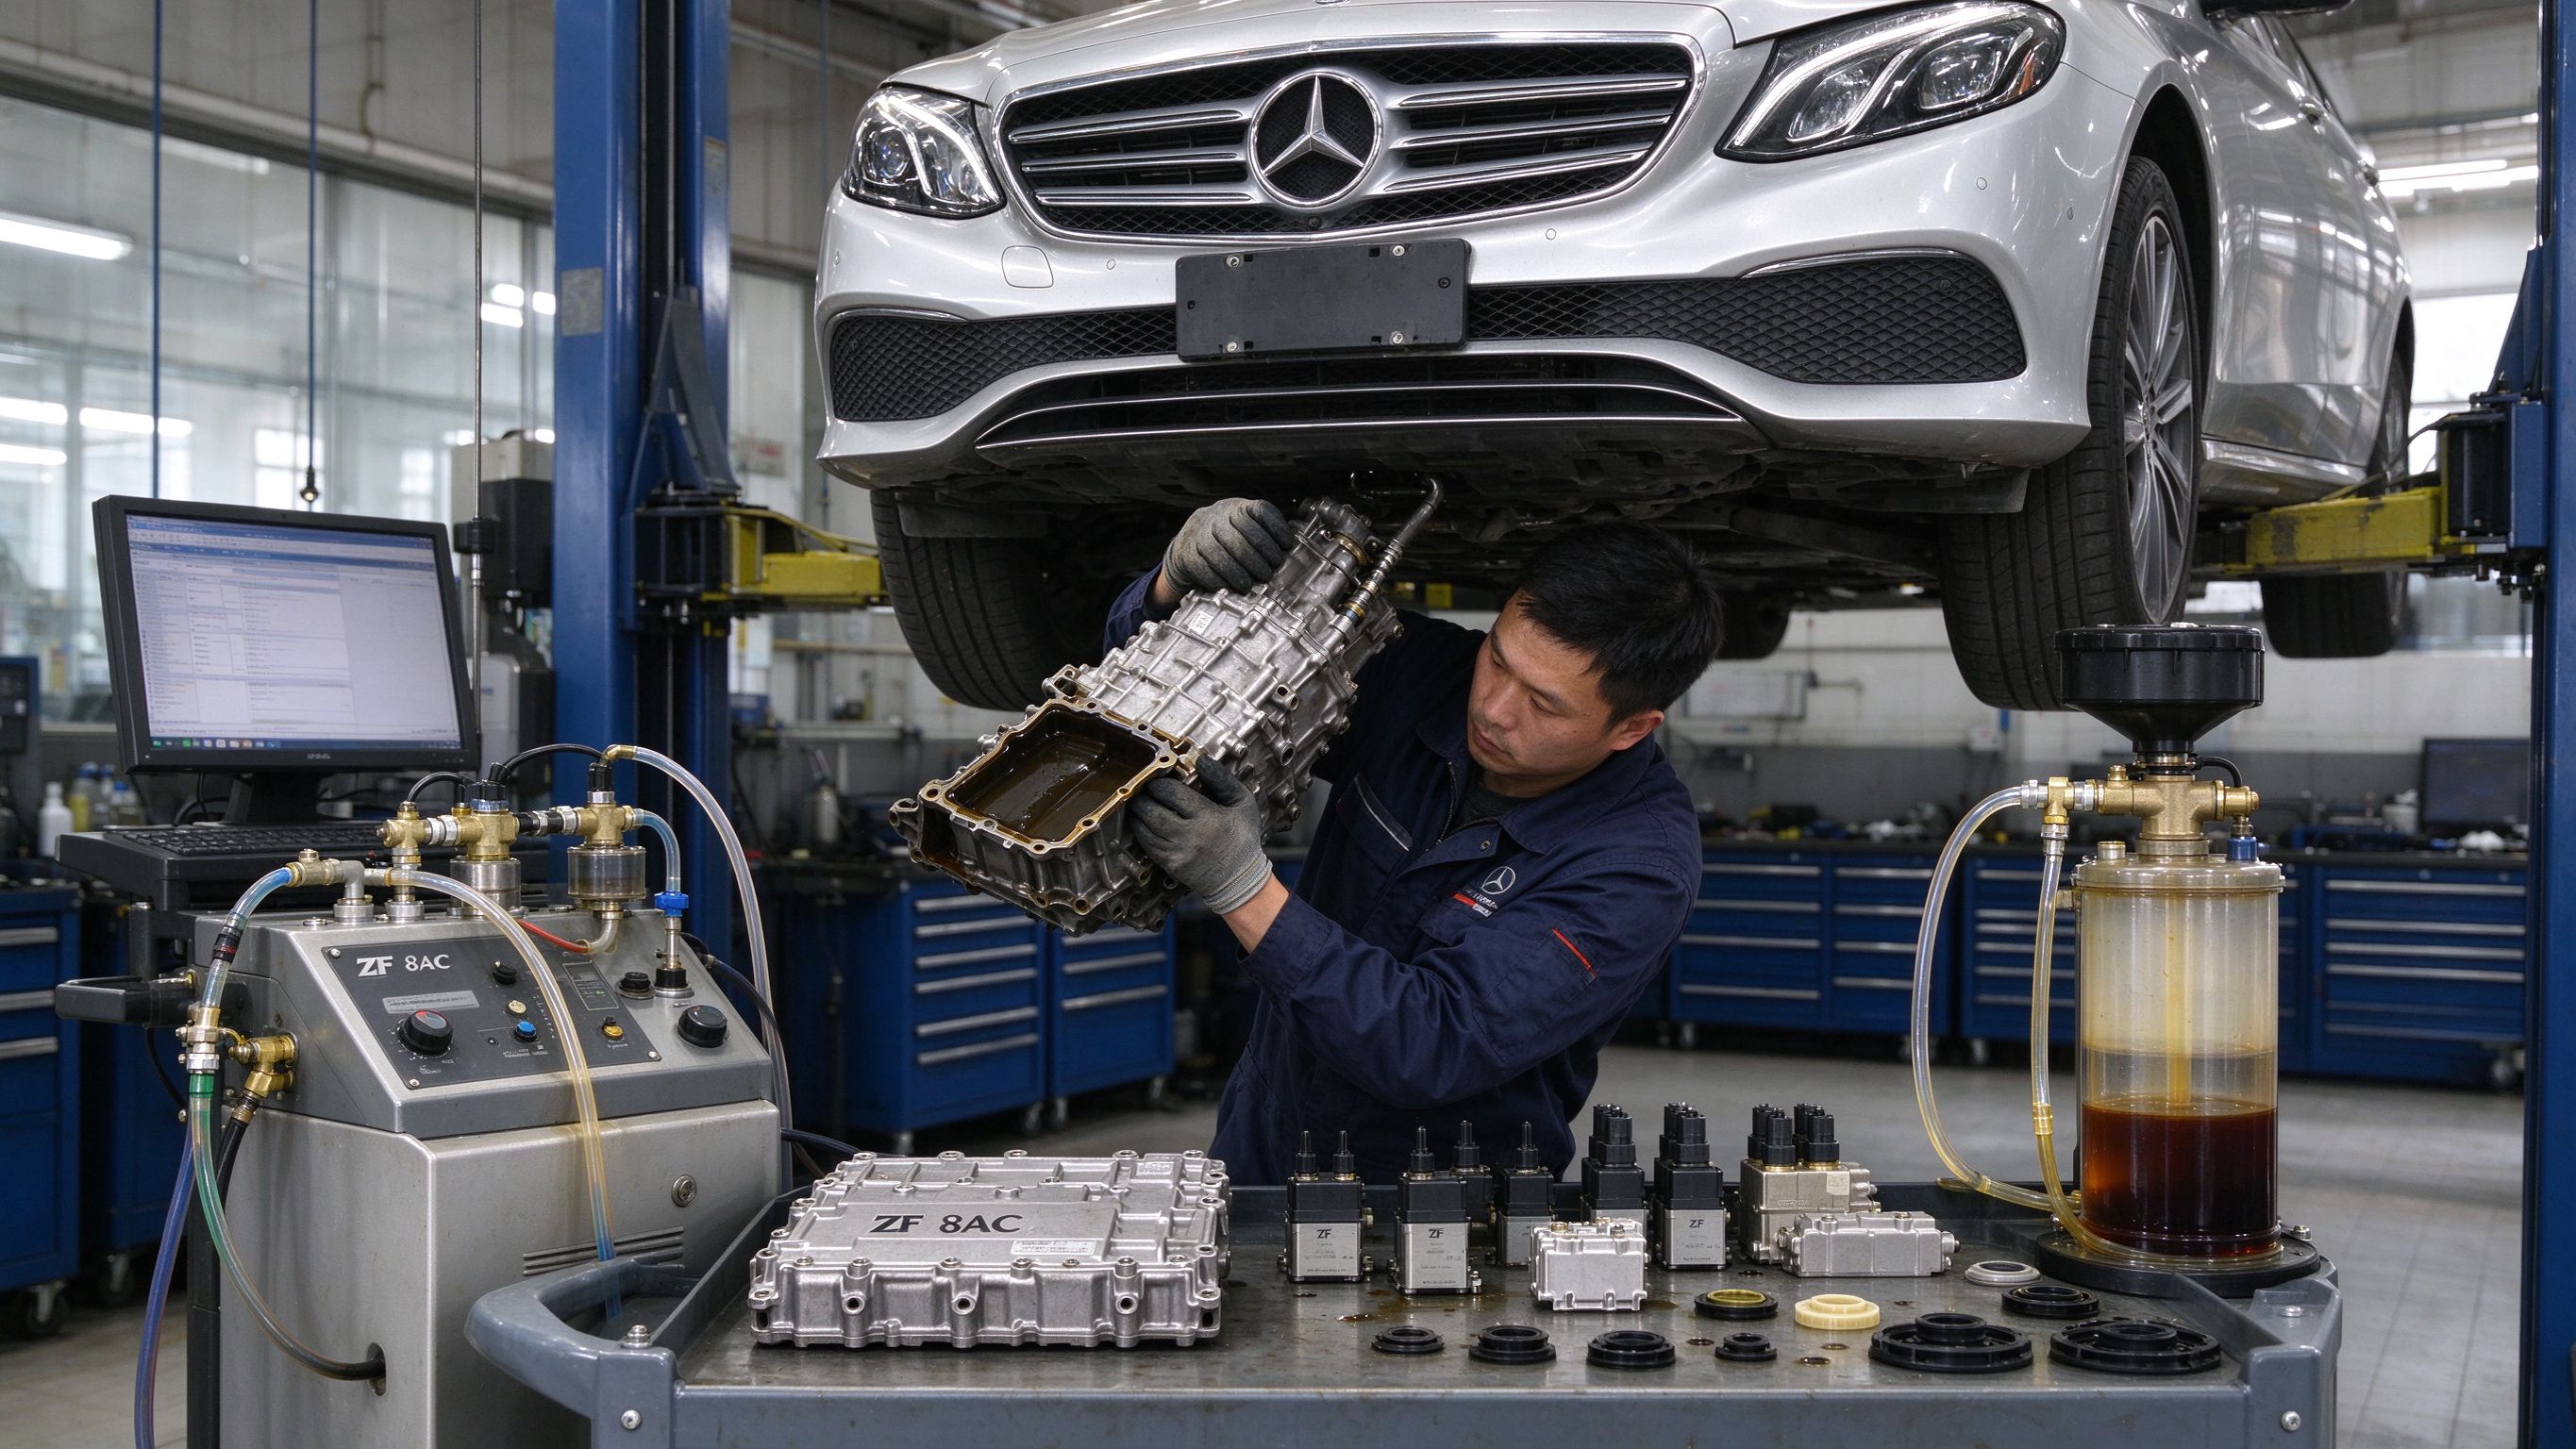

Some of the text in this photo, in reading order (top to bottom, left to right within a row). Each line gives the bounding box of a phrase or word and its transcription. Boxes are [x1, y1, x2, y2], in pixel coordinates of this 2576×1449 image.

[357, 954, 452, 977] ZF 8AC
[869, 1214, 1023, 1234] ZF 8AC
[1689, 1219, 1705, 1228] ZF
[1316, 1229, 1332, 1239] ZF
[1429, 1228, 1445, 1239] ZF
